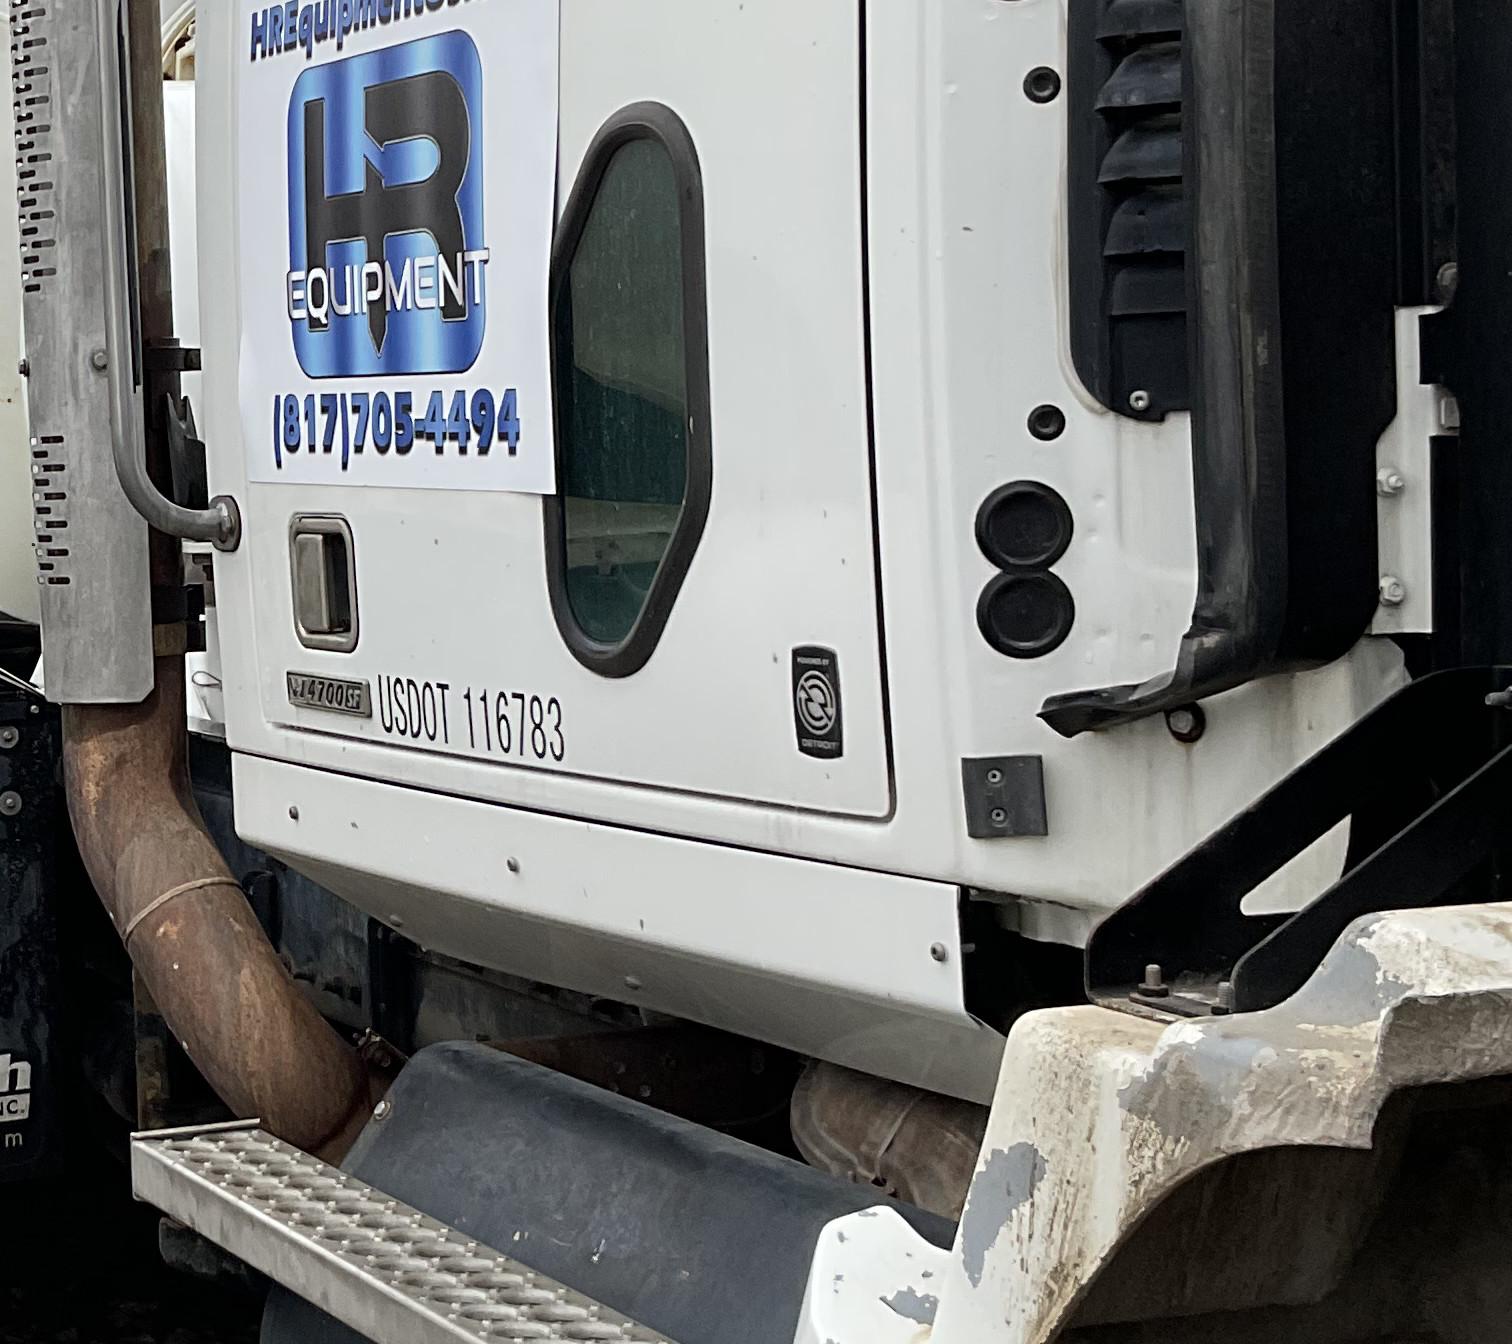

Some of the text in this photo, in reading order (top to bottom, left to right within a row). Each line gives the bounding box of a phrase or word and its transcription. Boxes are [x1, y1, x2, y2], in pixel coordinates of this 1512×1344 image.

[287, 247, 490, 325] EQUIPMENT
[273, 388, 521, 471] (817)705-4494
[377, 673, 565, 762] USDOT 116783
